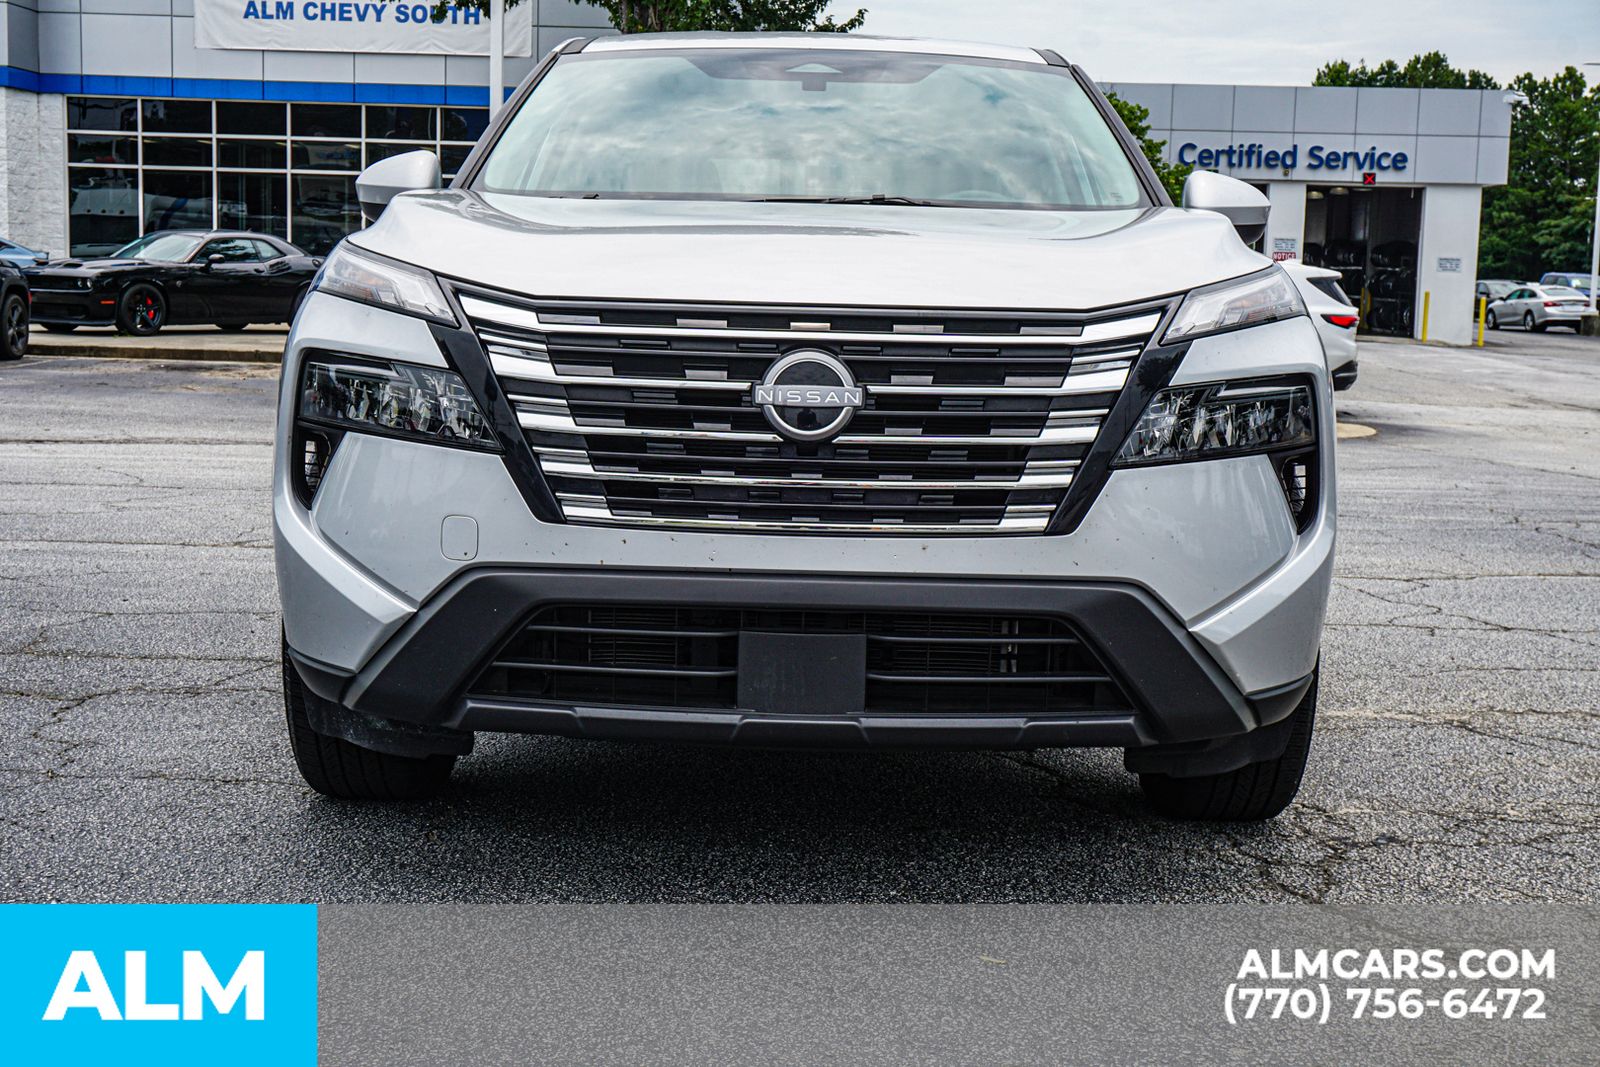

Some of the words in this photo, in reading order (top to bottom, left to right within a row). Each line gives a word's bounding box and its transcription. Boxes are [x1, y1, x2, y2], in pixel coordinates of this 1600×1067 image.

[243, 1, 294, 20] ALM
[303, 2, 386, 22] CHEVY
[1178, 142, 1298, 169] Certified
[1306, 145, 1408, 171] Service
[1273, 252, 1296, 260] NOTICE
[758, 389, 859, 403] NISSAN
